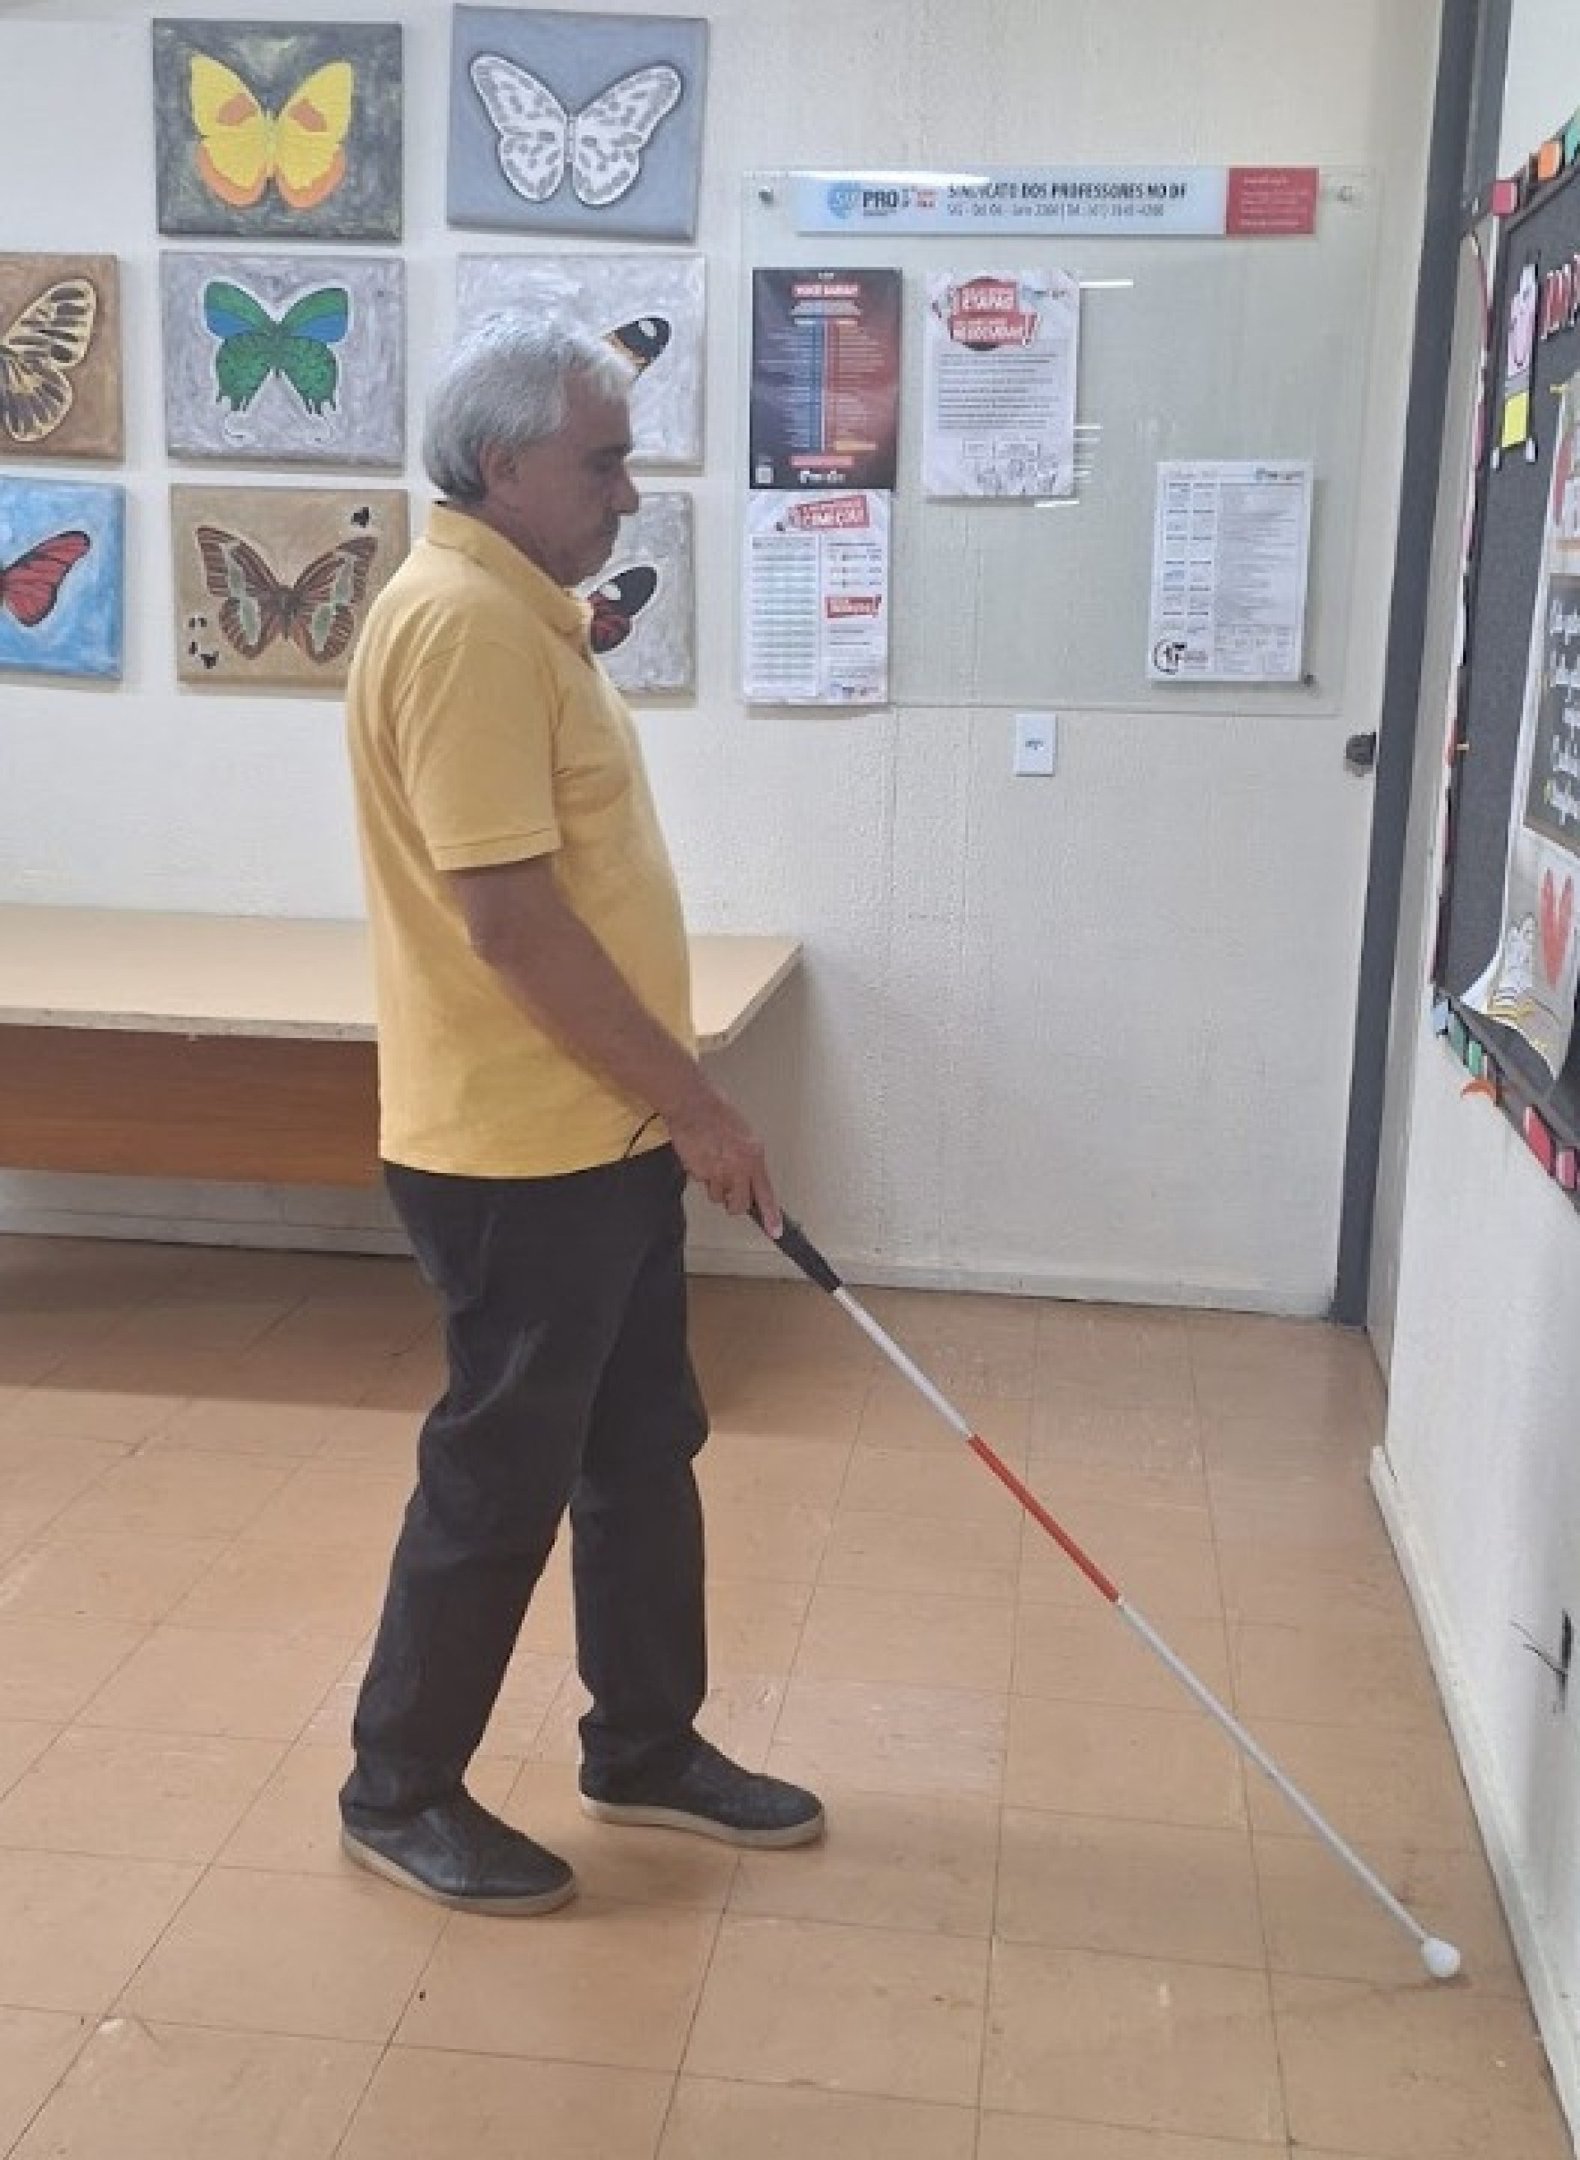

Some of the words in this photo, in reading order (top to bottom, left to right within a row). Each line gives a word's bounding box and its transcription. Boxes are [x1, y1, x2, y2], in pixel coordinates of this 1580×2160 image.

[1022, 183, 1047, 198] DOS
[1052, 183, 1143, 198] PROFESSORES
[1147, 183, 1167, 198] NO
[1169, 183, 1186, 198] DF
